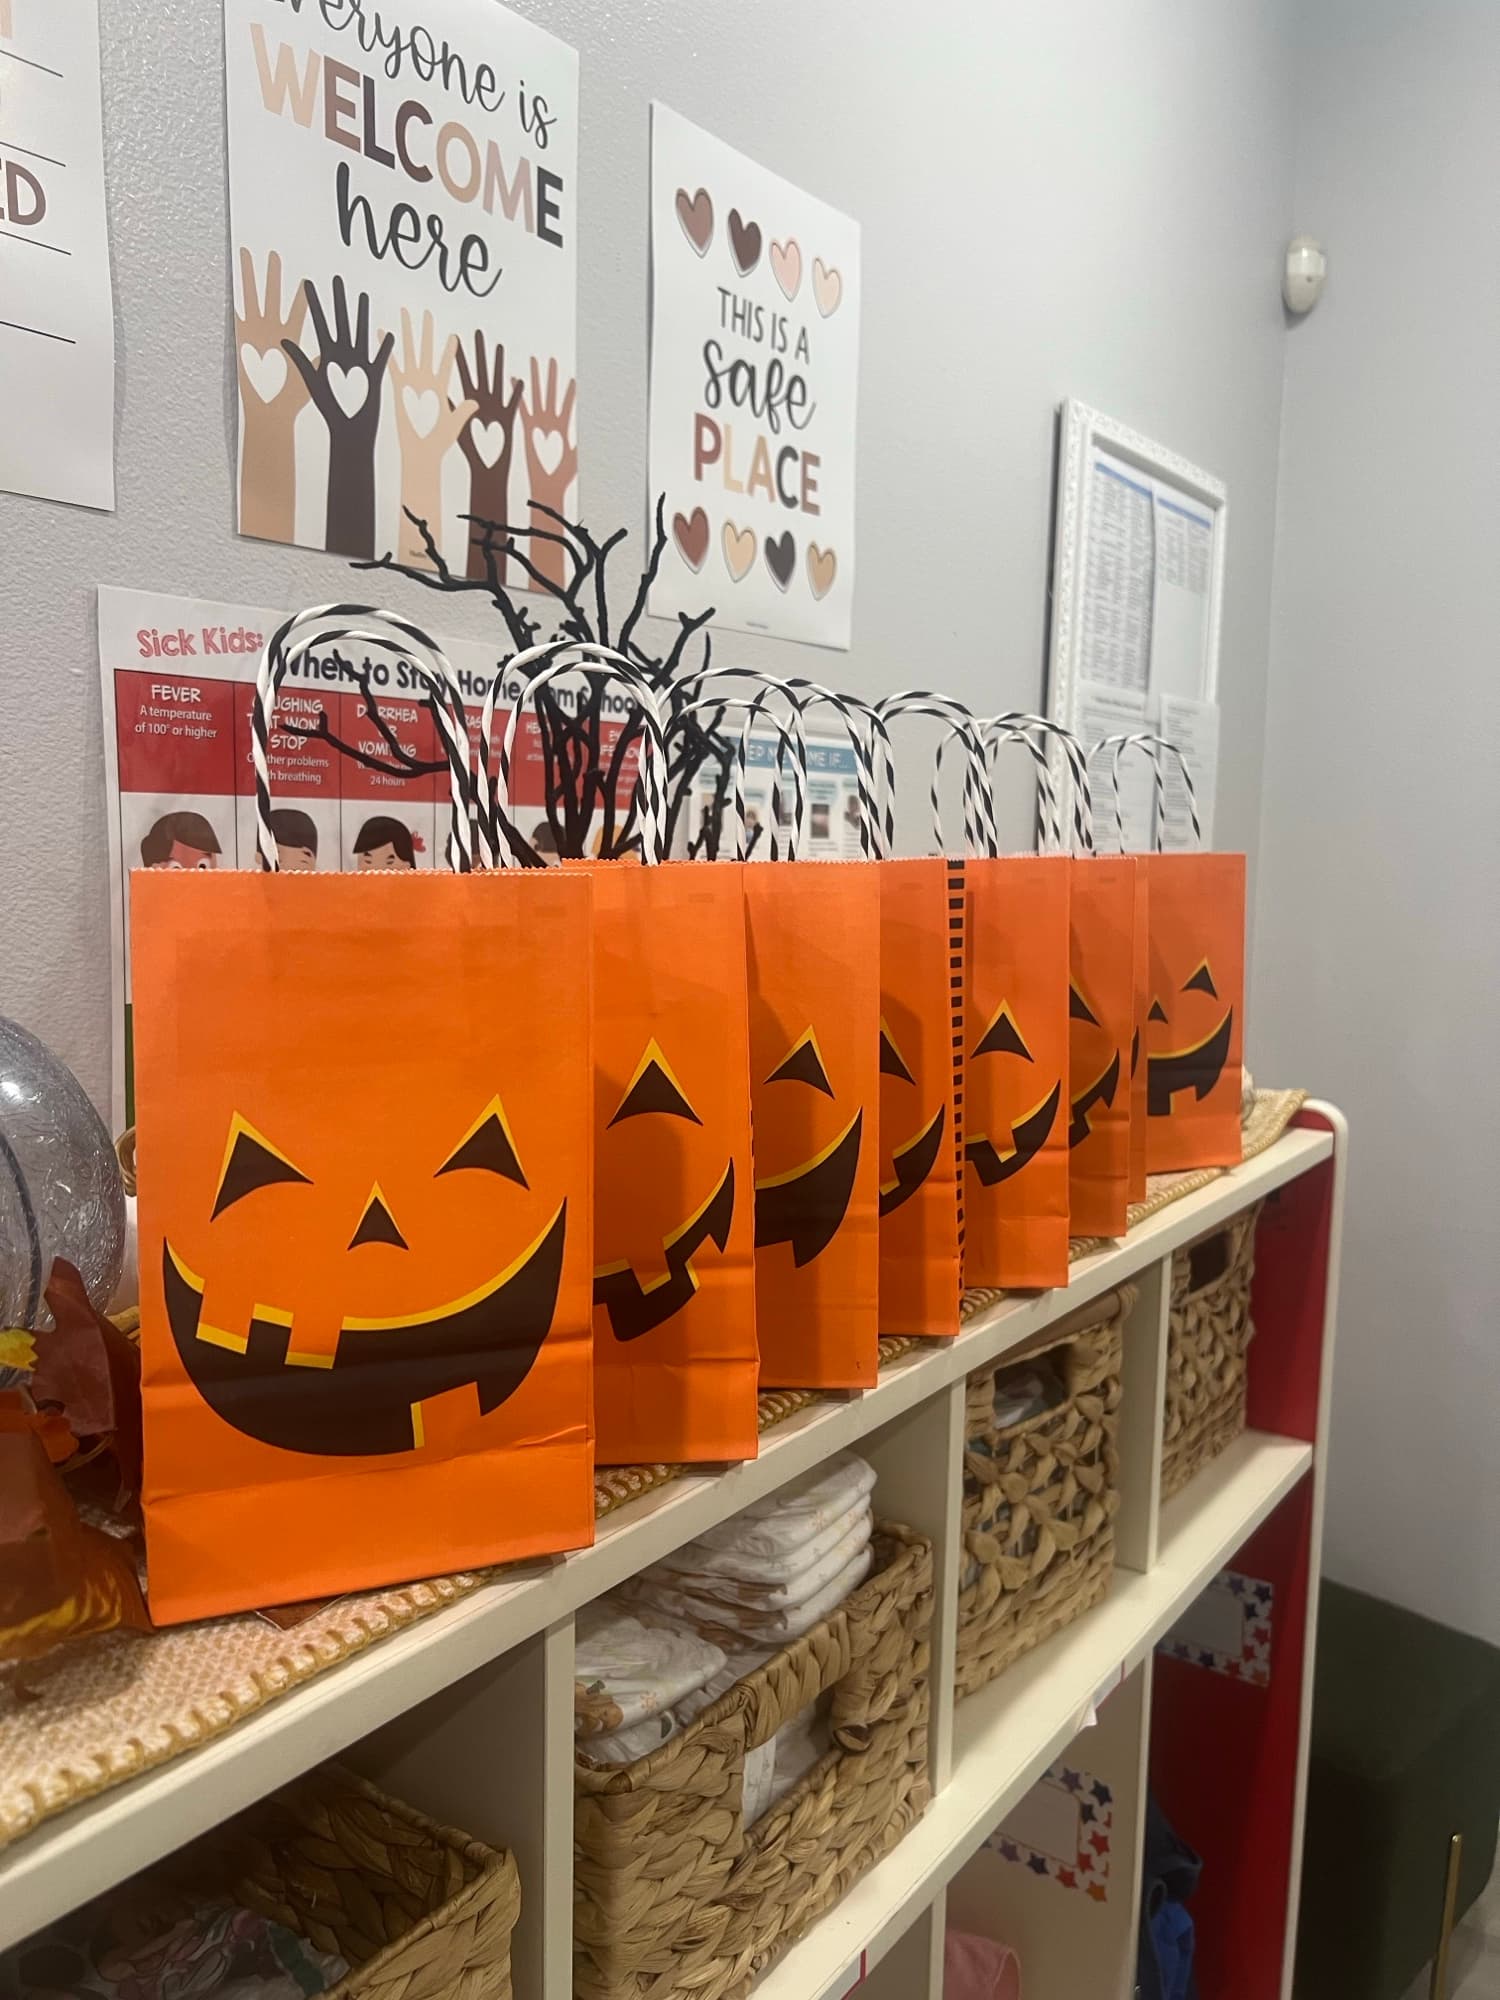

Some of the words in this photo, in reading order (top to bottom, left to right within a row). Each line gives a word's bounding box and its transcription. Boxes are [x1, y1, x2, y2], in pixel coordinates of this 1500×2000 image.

[272, 0, 506, 112] eryone
[519, 80, 558, 149] is
[249, 22, 564, 248] WELCOME
[336, 161, 503, 297] here
[717, 286, 764, 343] THIS
[771, 312, 788, 353] IS
[794, 326, 811, 365] A
[703, 339, 817, 435] safe
[693, 412, 821, 517] PLACE
[137, 629, 197, 658] Sick
[202, 627, 264, 656] Kids:
[152, 685, 201, 703] FEVER
[362, 657, 389, 686] to
[579, 685, 638, 714] Shoo
[140, 705, 148, 716] A
[149, 706, 212, 721] temperature
[252, 695, 323, 714] UGHING
[356, 703, 418, 723] DRRHEA
[135, 722, 146, 733] of
[172, 727, 183, 736] or
[185, 725, 217, 740] higher
[246, 713, 280, 731] TT
[285, 716, 320, 731] WON'
[377, 725, 397, 738] R
[270, 734, 308, 751] STOP
[358, 741, 417, 758] VOMING
[266, 753, 286, 765] ther
[287, 755, 329, 768] problems
[278, 771, 322, 785] breathing
[370, 776, 381, 786] 24
